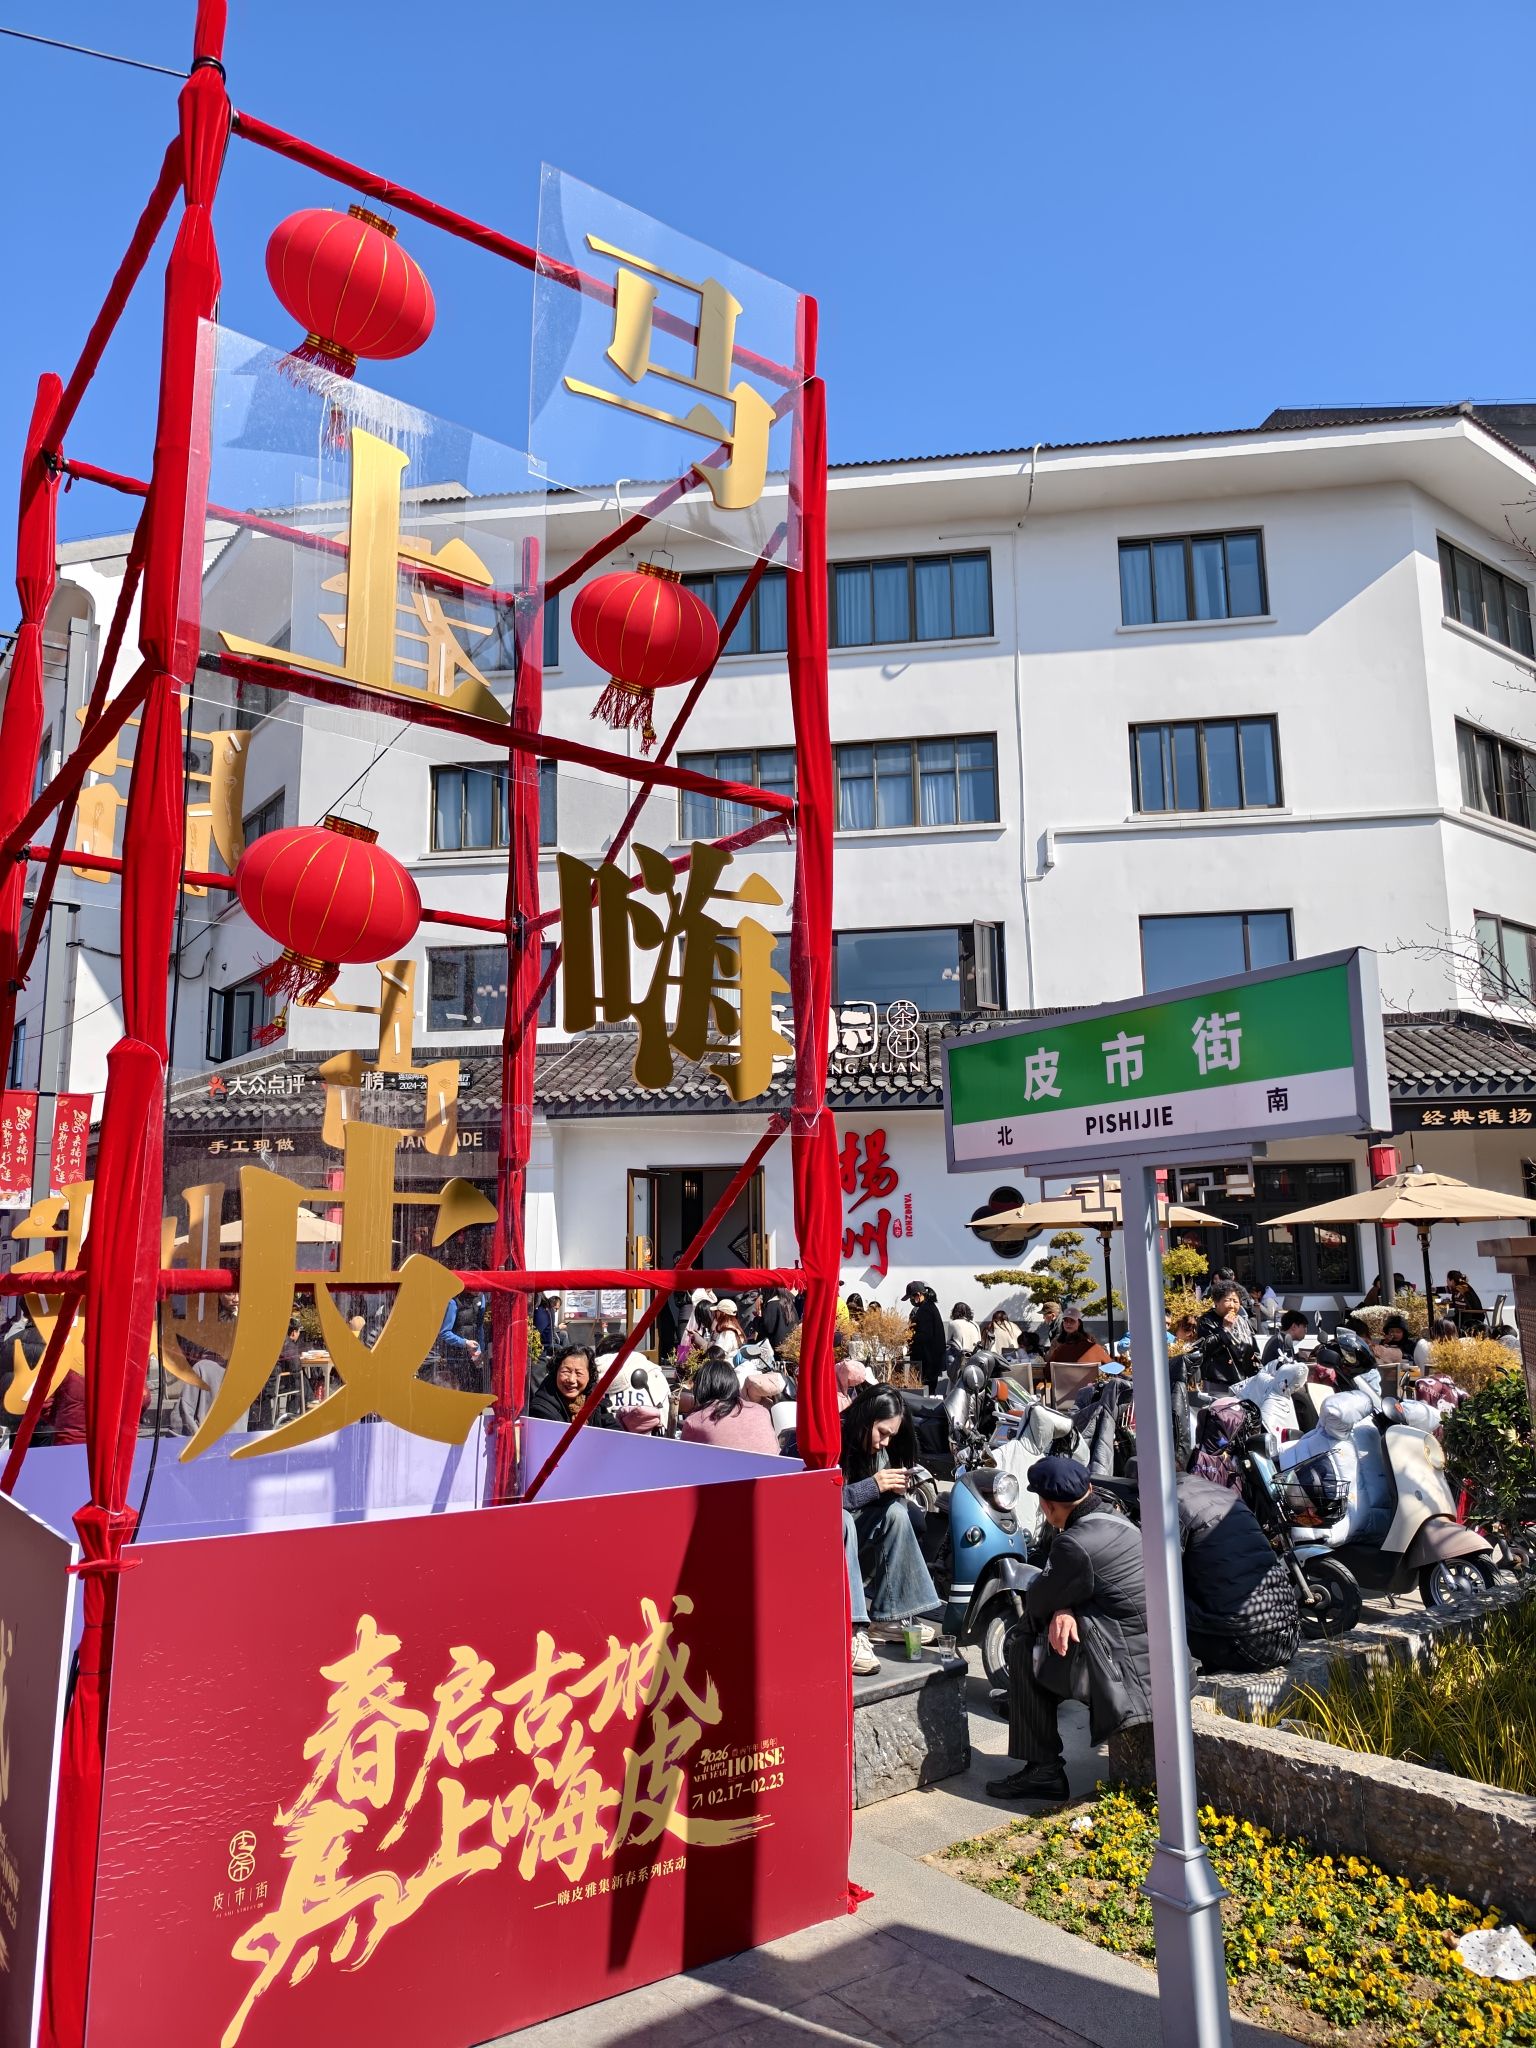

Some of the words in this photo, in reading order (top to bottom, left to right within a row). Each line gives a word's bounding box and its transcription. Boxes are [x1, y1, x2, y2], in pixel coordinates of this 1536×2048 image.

[869, 1062, 921, 1074] YUAN
[1023, 1010, 1243, 1102] 皮市街
[997, 1124, 1014, 1147] 北
[1085, 1105, 1174, 1136] PISHIJIE
[1266, 1086, 1289, 1113] 南
[1421, 1107, 1533, 1126] 经典淮扬
[209, 1138, 295, 1154] 手工现做
[904, 1193, 913, 1238] YANGZHOU
[695, 1743, 731, 1768] 2026
[727, 1746, 785, 1778] HORSE
